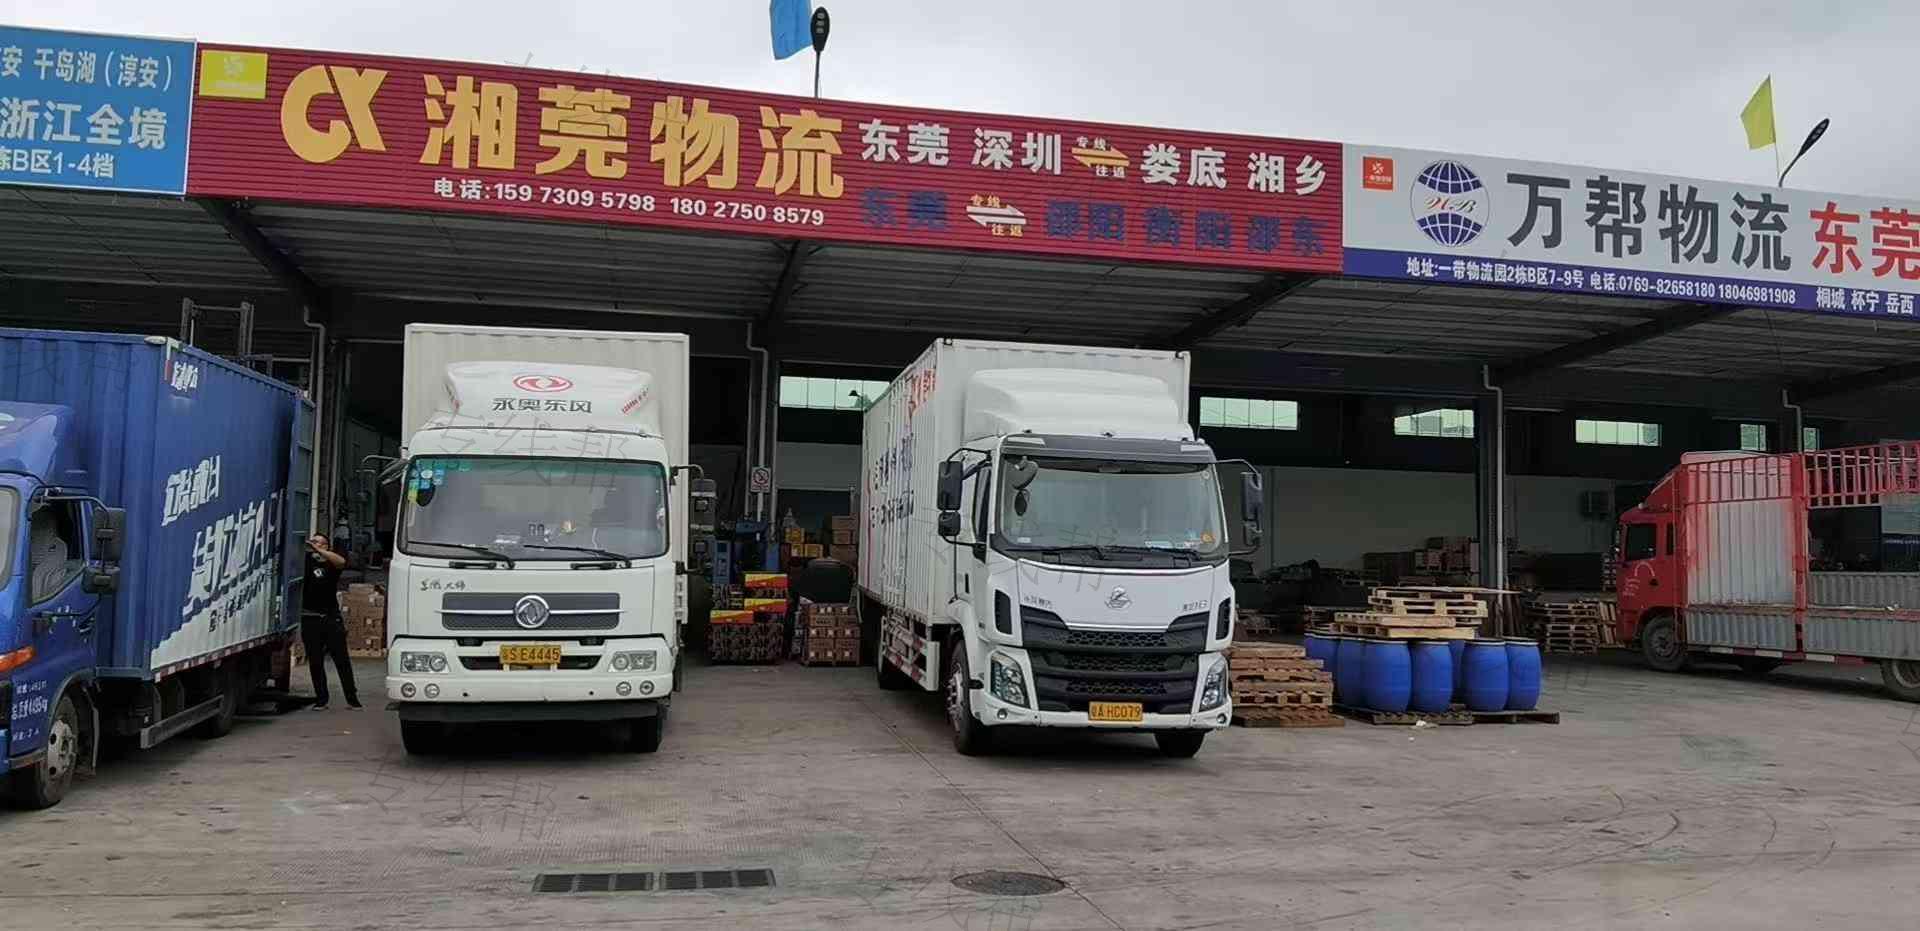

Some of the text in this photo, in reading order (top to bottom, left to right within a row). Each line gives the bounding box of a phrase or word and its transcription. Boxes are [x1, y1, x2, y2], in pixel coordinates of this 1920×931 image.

[0, 97, 167, 150] 浙江全境
[419, 74, 845, 198] 湘莞物流
[859, 119, 1061, 175] 东莞 深圳
[1140, 143, 1326, 195] 娄底 湘乡
[539, 186, 594, 206] 7309
[601, 192, 655, 211] 5798
[670, 197, 707, 215] 180
[713, 201, 766, 221] 2750
[773, 207, 824, 225] 8579
[858, 187, 950, 230] 东莞
[1507, 172, 1792, 272] 万帮物流
[1810, 201, 1920, 280] 东莞
[1719, 284, 1796, 304] 18046981908
[1886, 293, 1914, 314] 岳西
